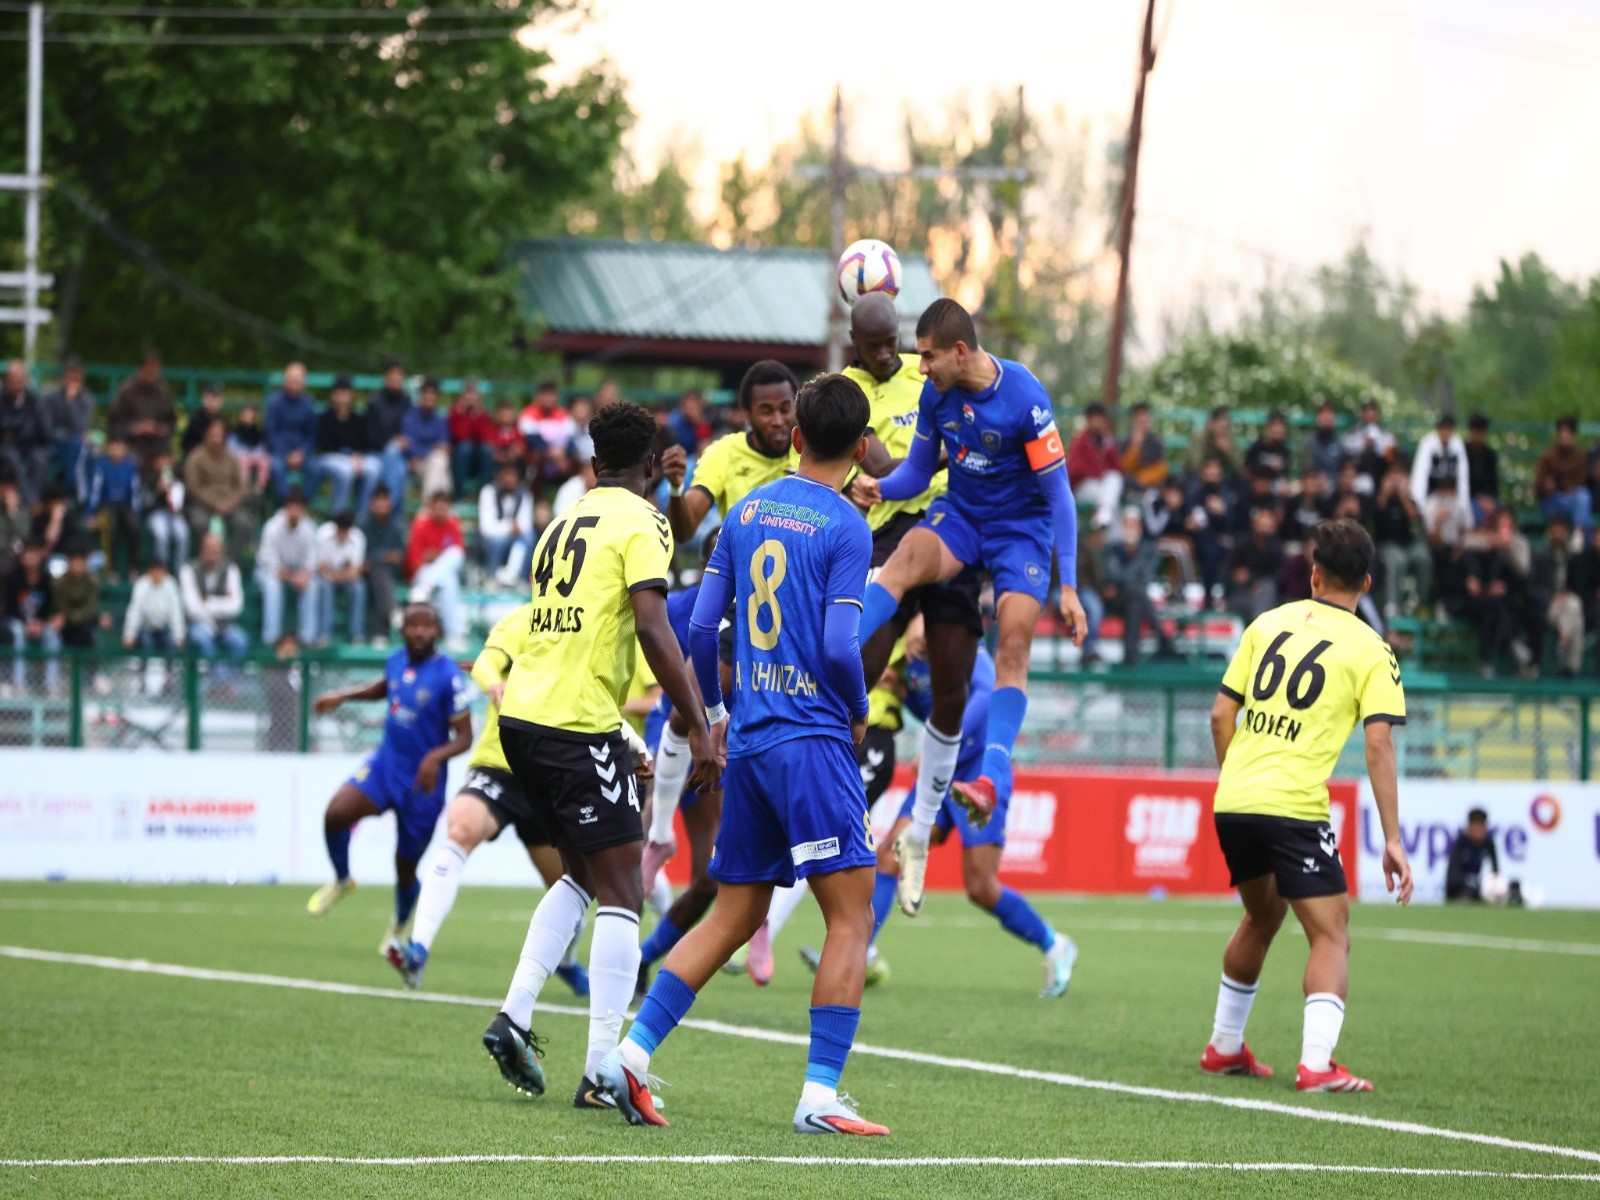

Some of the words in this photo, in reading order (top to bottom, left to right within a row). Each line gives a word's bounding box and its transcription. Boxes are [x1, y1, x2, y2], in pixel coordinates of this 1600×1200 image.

[1046, 438, 1059, 454] C
[758, 499, 830, 528] SREENIDHI
[759, 514, 817, 538] UNIVERSITY
[534, 515, 601, 598] 45
[748, 539, 787, 651] 8
[529, 606, 585, 635] HARLES
[1252, 630, 1334, 711] 66
